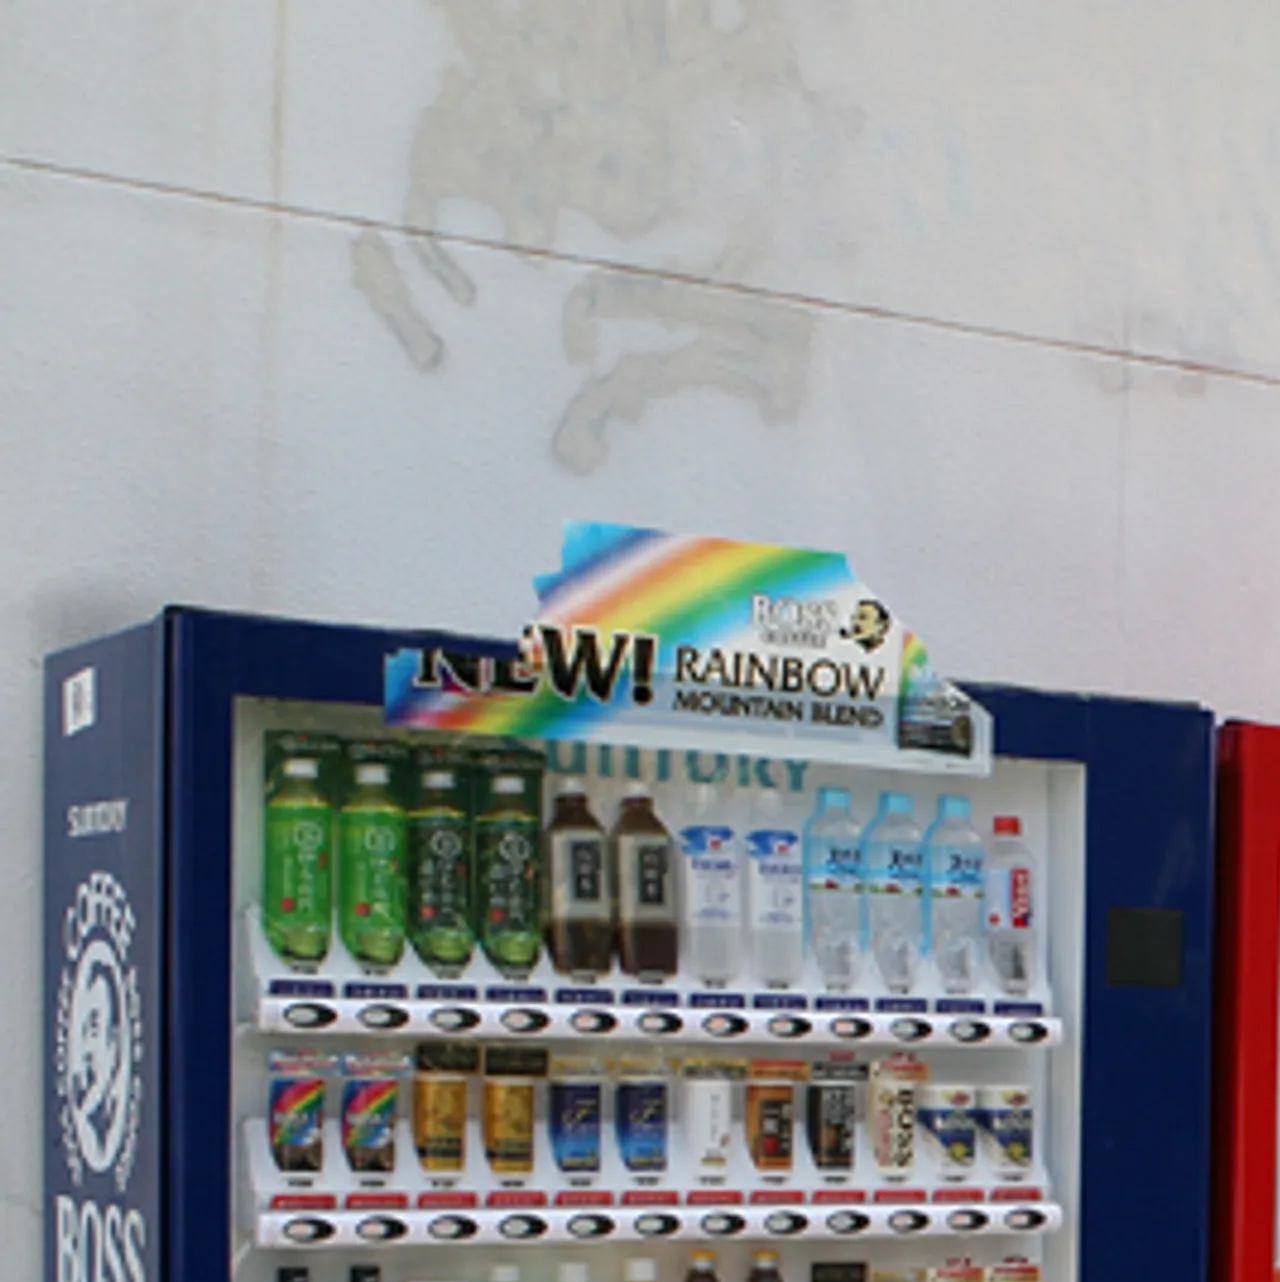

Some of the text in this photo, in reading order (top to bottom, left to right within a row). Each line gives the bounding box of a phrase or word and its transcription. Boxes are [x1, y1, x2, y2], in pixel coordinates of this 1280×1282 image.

[412, 625, 658, 706] NEW!
[675, 645, 885, 703] RAINBOW
[673, 688, 803, 722] MOUNTAIN
[811, 701, 885, 730] BLEND
